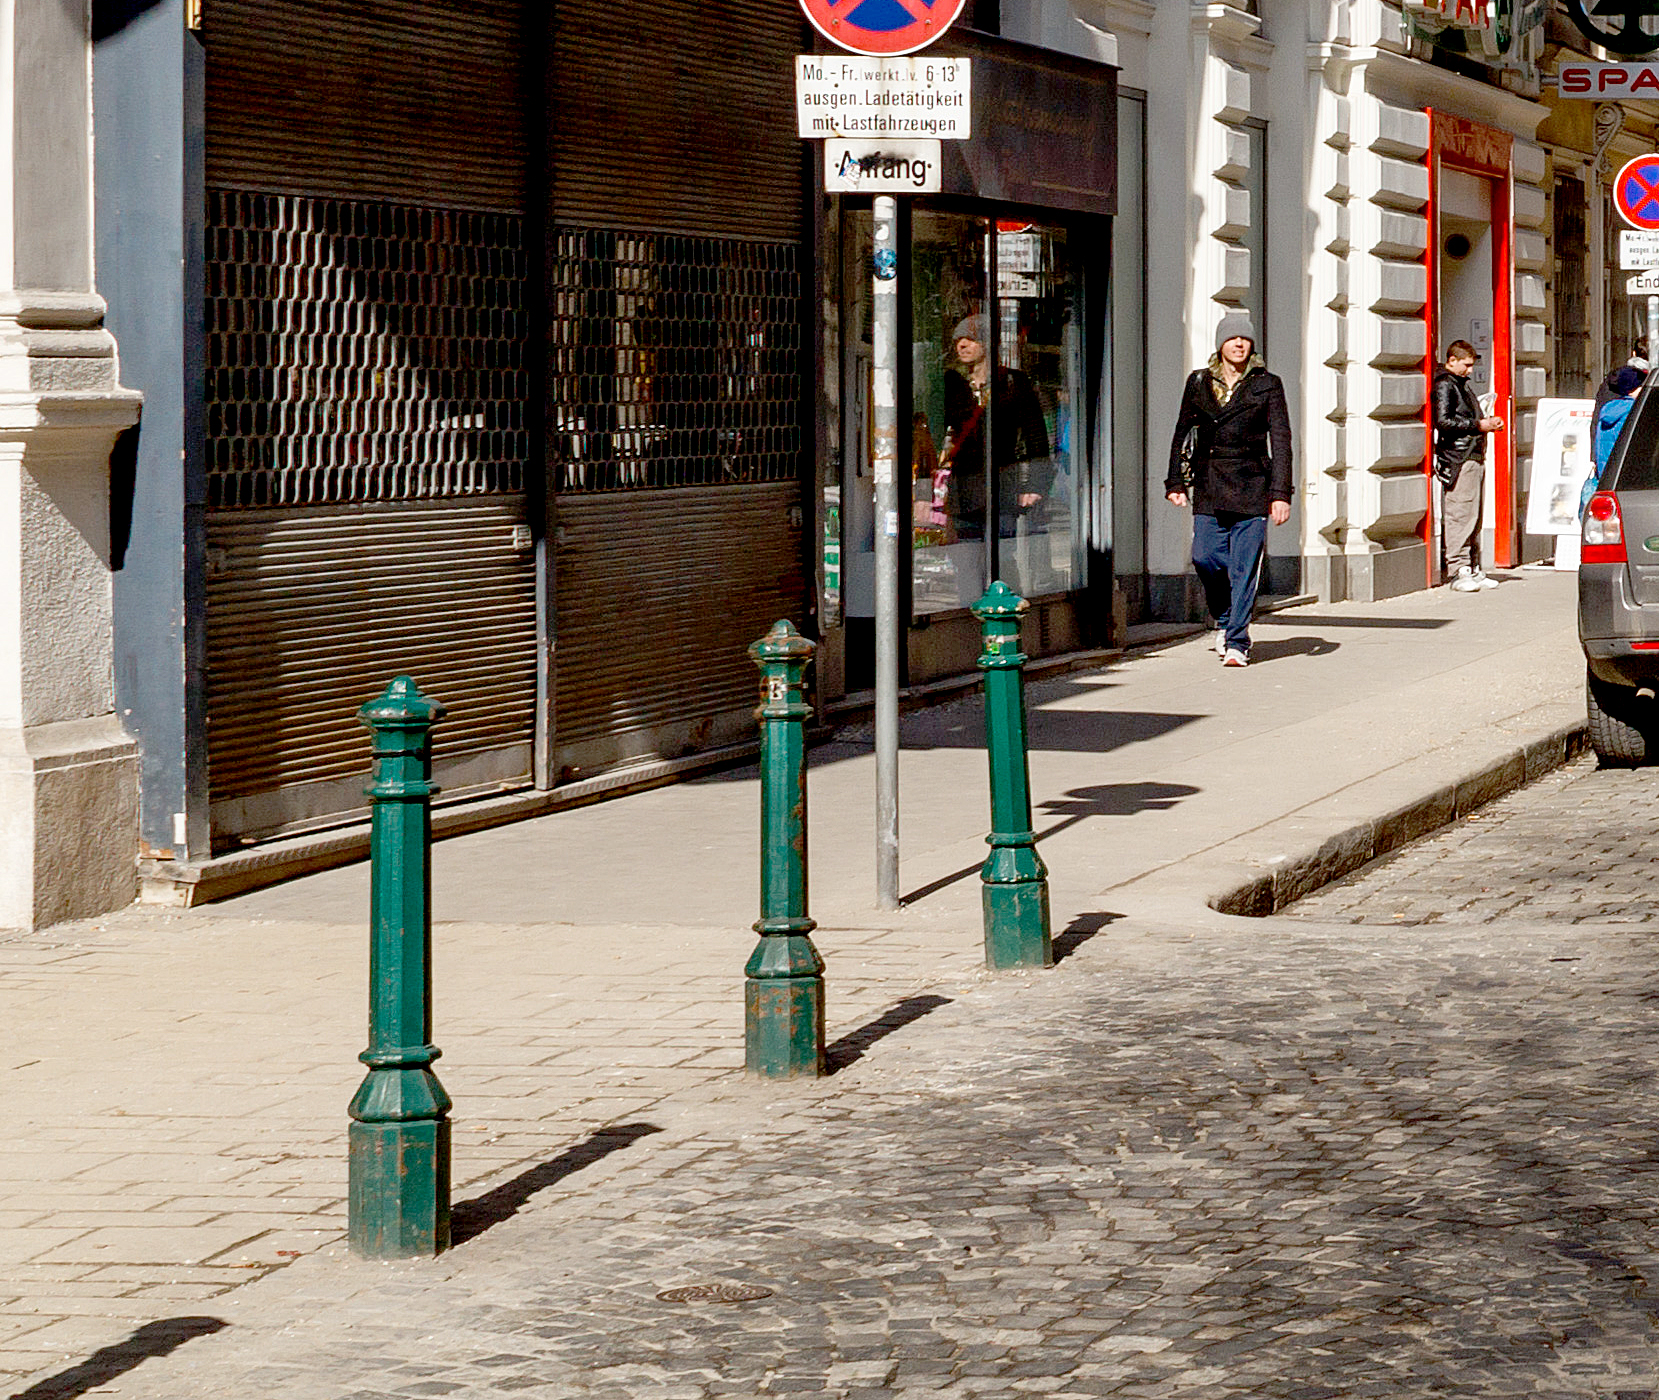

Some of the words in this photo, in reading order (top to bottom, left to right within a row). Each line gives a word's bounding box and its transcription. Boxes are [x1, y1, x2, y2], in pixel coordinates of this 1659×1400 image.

[804, 93, 863, 110] ausgen.
[865, 89, 963, 110] Ladetätigkeit
[812, 114, 835, 131] mit
[843, 114, 956, 135] Lastfahrzeugen
